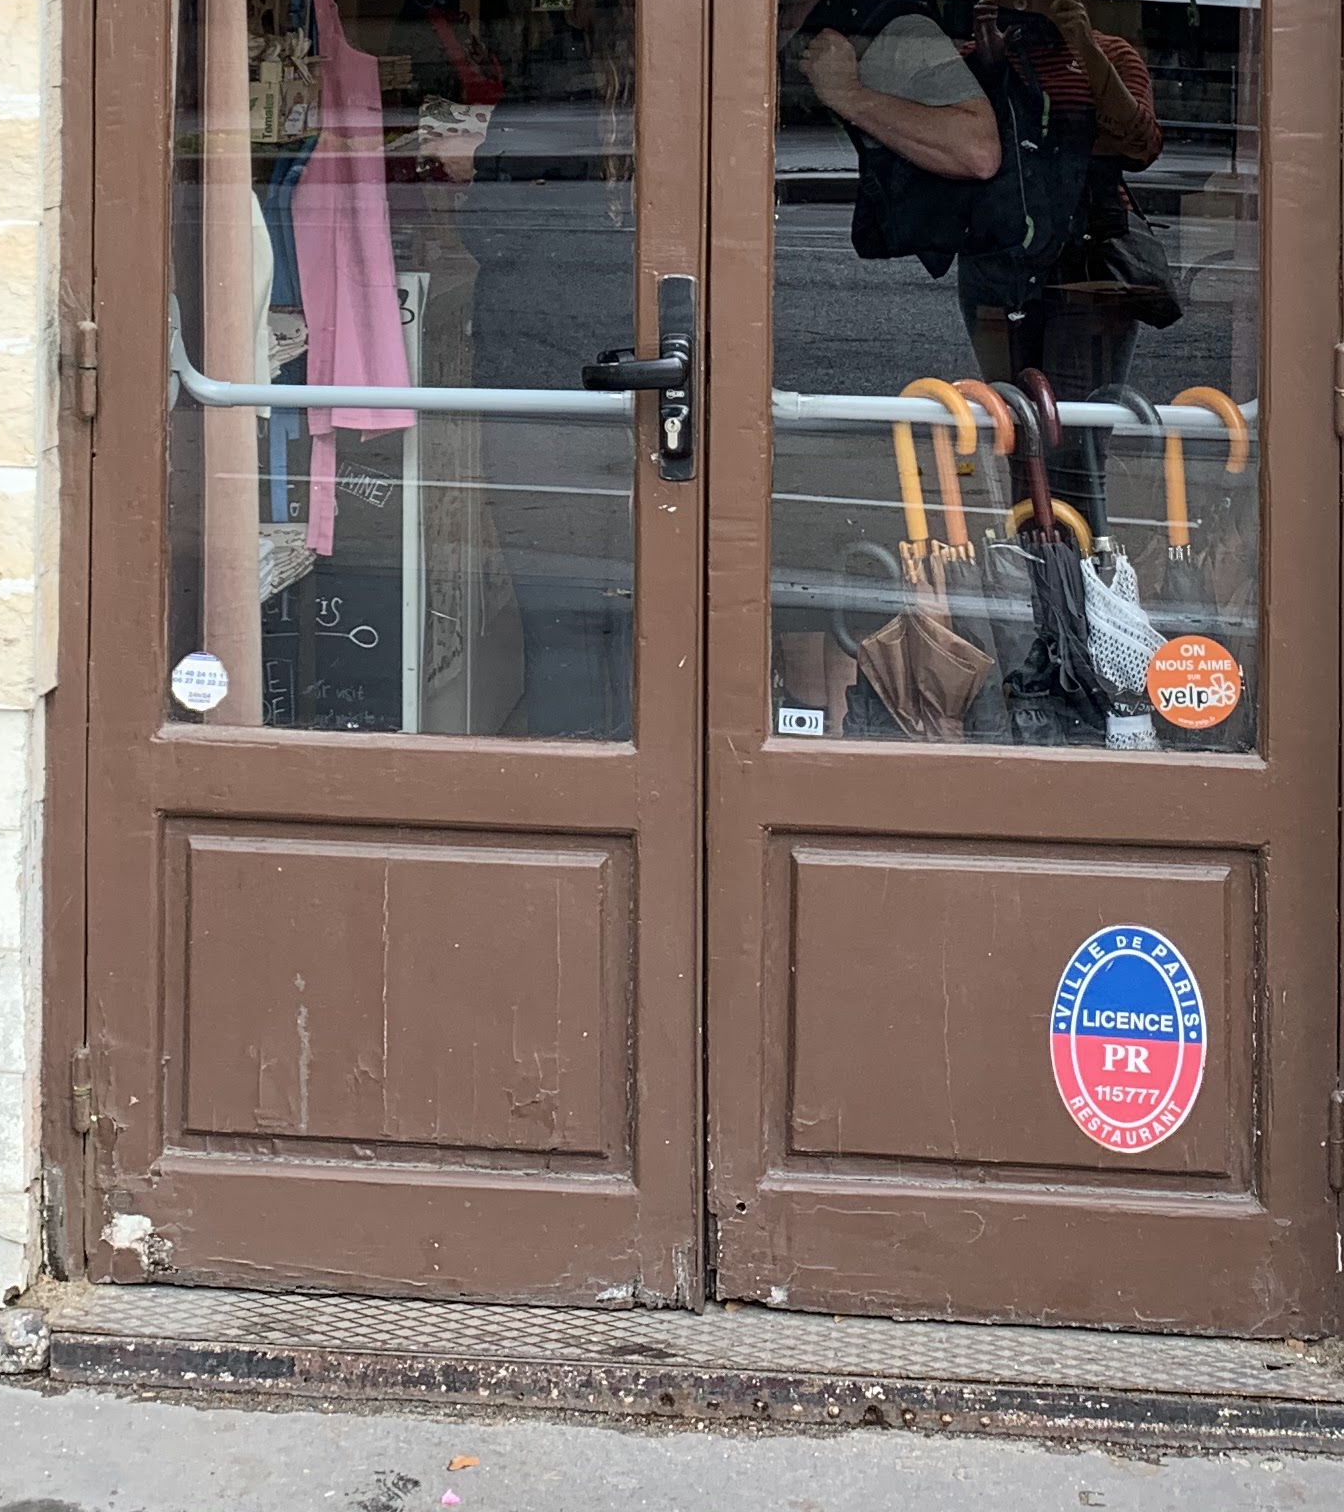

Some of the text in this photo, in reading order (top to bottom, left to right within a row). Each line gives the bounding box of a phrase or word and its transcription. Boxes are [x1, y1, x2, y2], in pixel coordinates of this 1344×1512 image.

[1180, 644, 1206, 657] ON
[1155, 659, 1232, 671] NOUS AIME
[1160, 686, 1209, 709] yelp
[1056, 935, 1200, 1027] VILLE DE PARIS
[1082, 1009, 1174, 1033] LICENCE
[1102, 1043, 1151, 1074] PR
[1094, 1085, 1160, 1105] 115777
[1070, 1094, 1182, 1146] RESTAURANT
